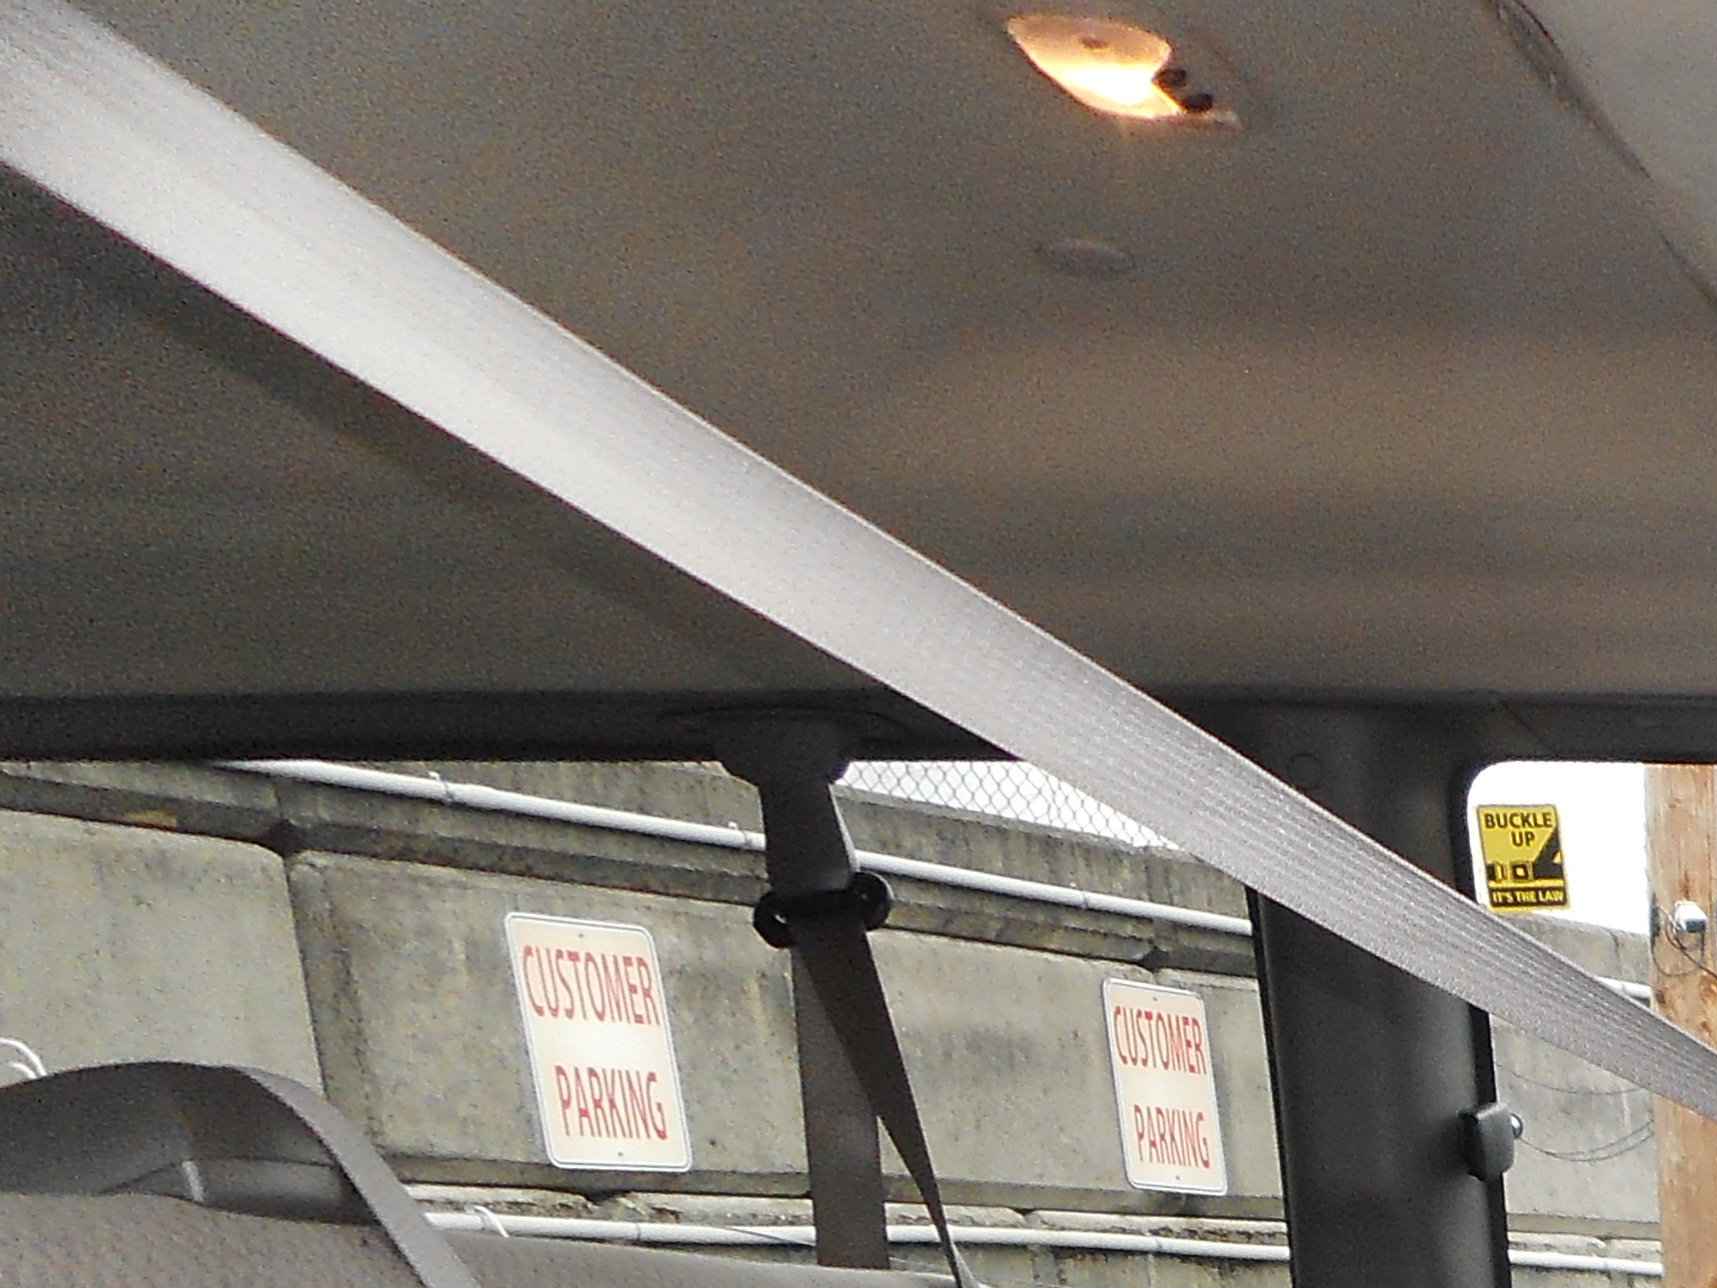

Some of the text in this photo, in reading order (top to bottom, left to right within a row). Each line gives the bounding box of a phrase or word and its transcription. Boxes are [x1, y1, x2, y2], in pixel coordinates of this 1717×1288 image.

[1483, 812, 1553, 829] BUCKLE
[1511, 831, 1535, 847] UP
[1492, 890, 1563, 903] IT'S THE LAW
[522, 945, 660, 1027] CUSTOMER
[1113, 1006, 1208, 1075] CUSTOMER
[554, 1065, 668, 1141] PARKING
[1133, 1104, 1211, 1169] PARKING
